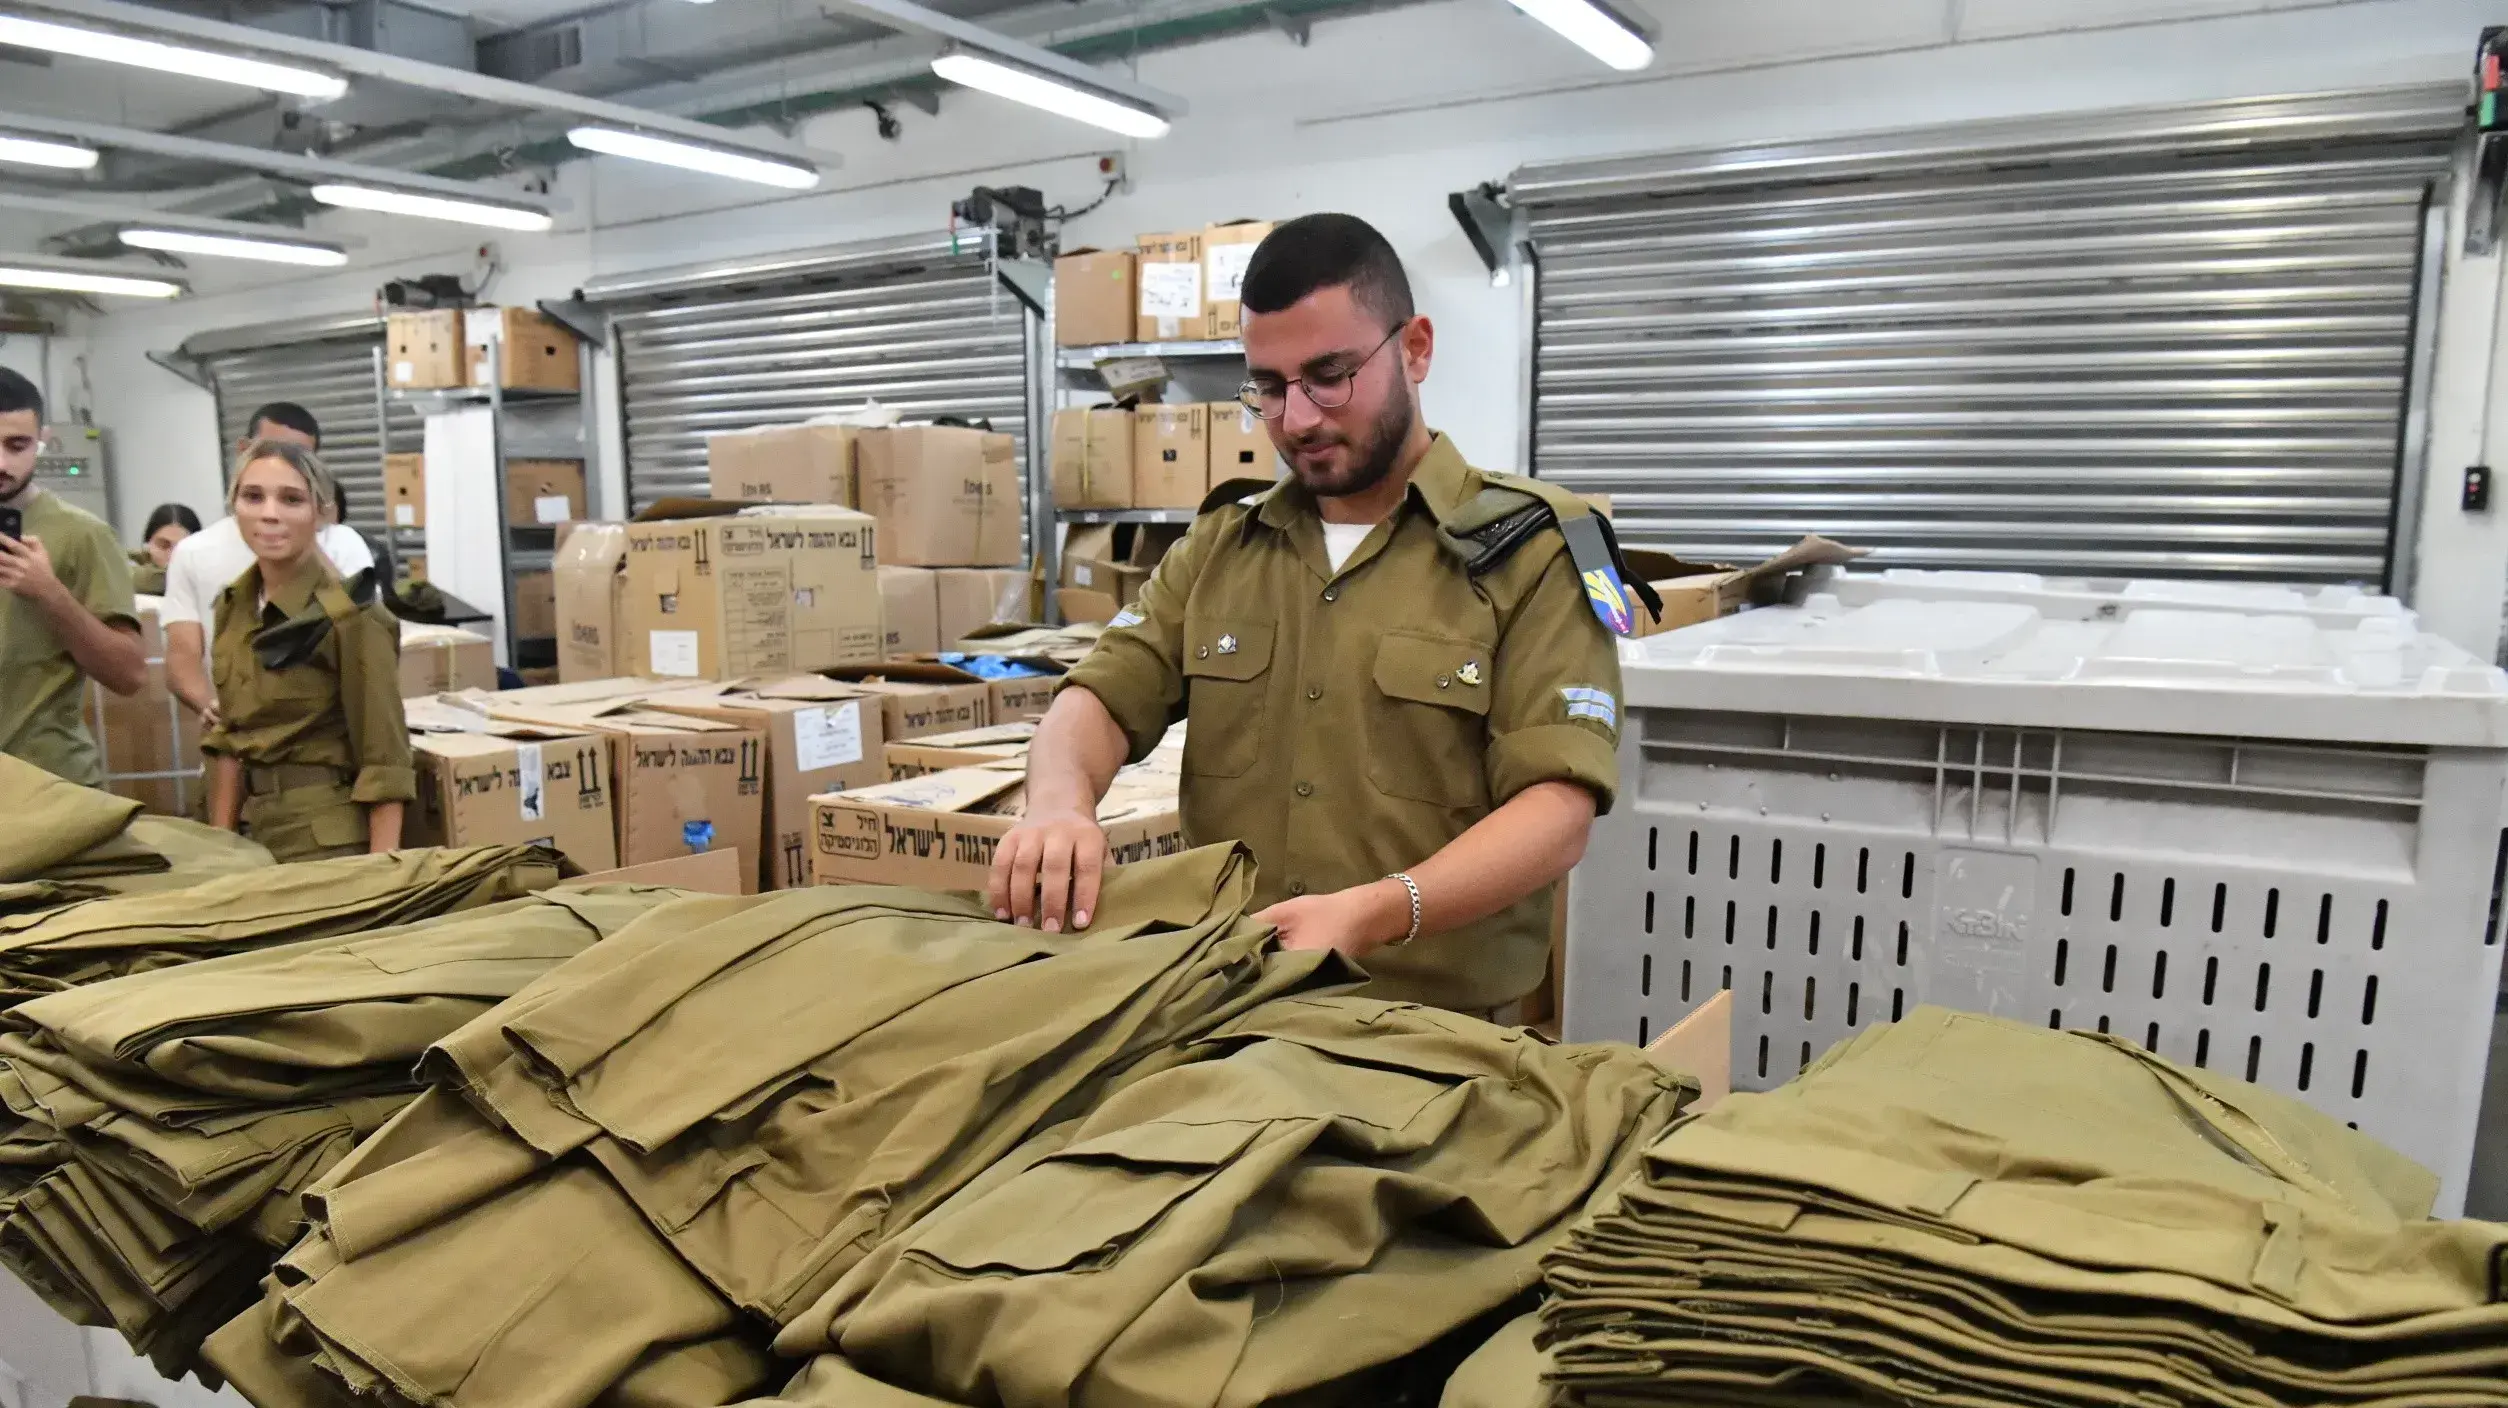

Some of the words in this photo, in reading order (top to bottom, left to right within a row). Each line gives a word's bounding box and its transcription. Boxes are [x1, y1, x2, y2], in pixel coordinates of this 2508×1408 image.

[635, 741, 676, 768] לישראל
[822, 812, 834, 828] צ
[857, 814, 876, 831] חיל
[820, 833, 877, 853] הלוגיסטיקה
[884, 813, 946, 859] לישראל
